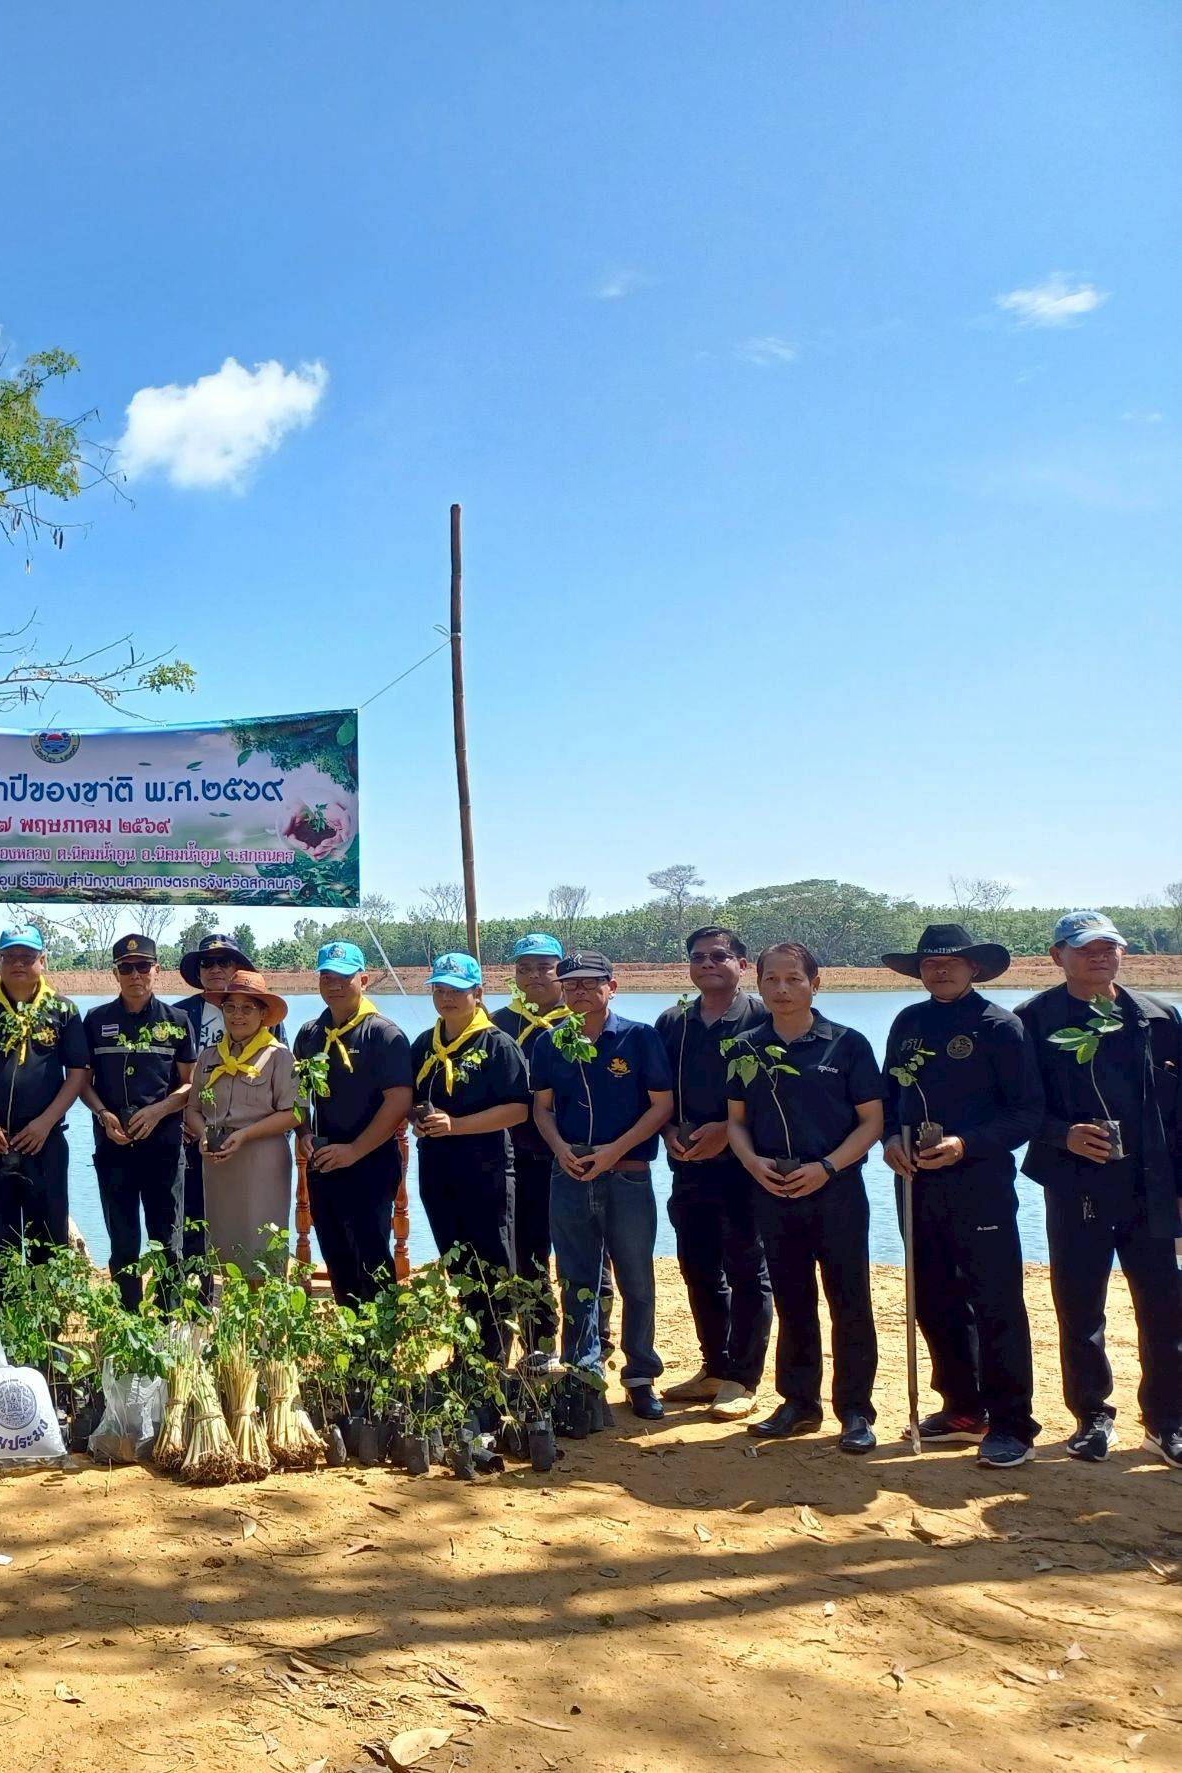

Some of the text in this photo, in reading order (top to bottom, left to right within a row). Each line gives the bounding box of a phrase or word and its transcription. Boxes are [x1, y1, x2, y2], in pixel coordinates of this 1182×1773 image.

[144, 777, 285, 803] พ.ศ.๒๕๖๙
[19, 817, 112, 836] พฤษภาคม
[117, 816, 171, 834] ๒๕๖๙
[225, 849, 294, 863] จ.สกลนคร
[21, 872, 64, 887] ร่วมกับ
